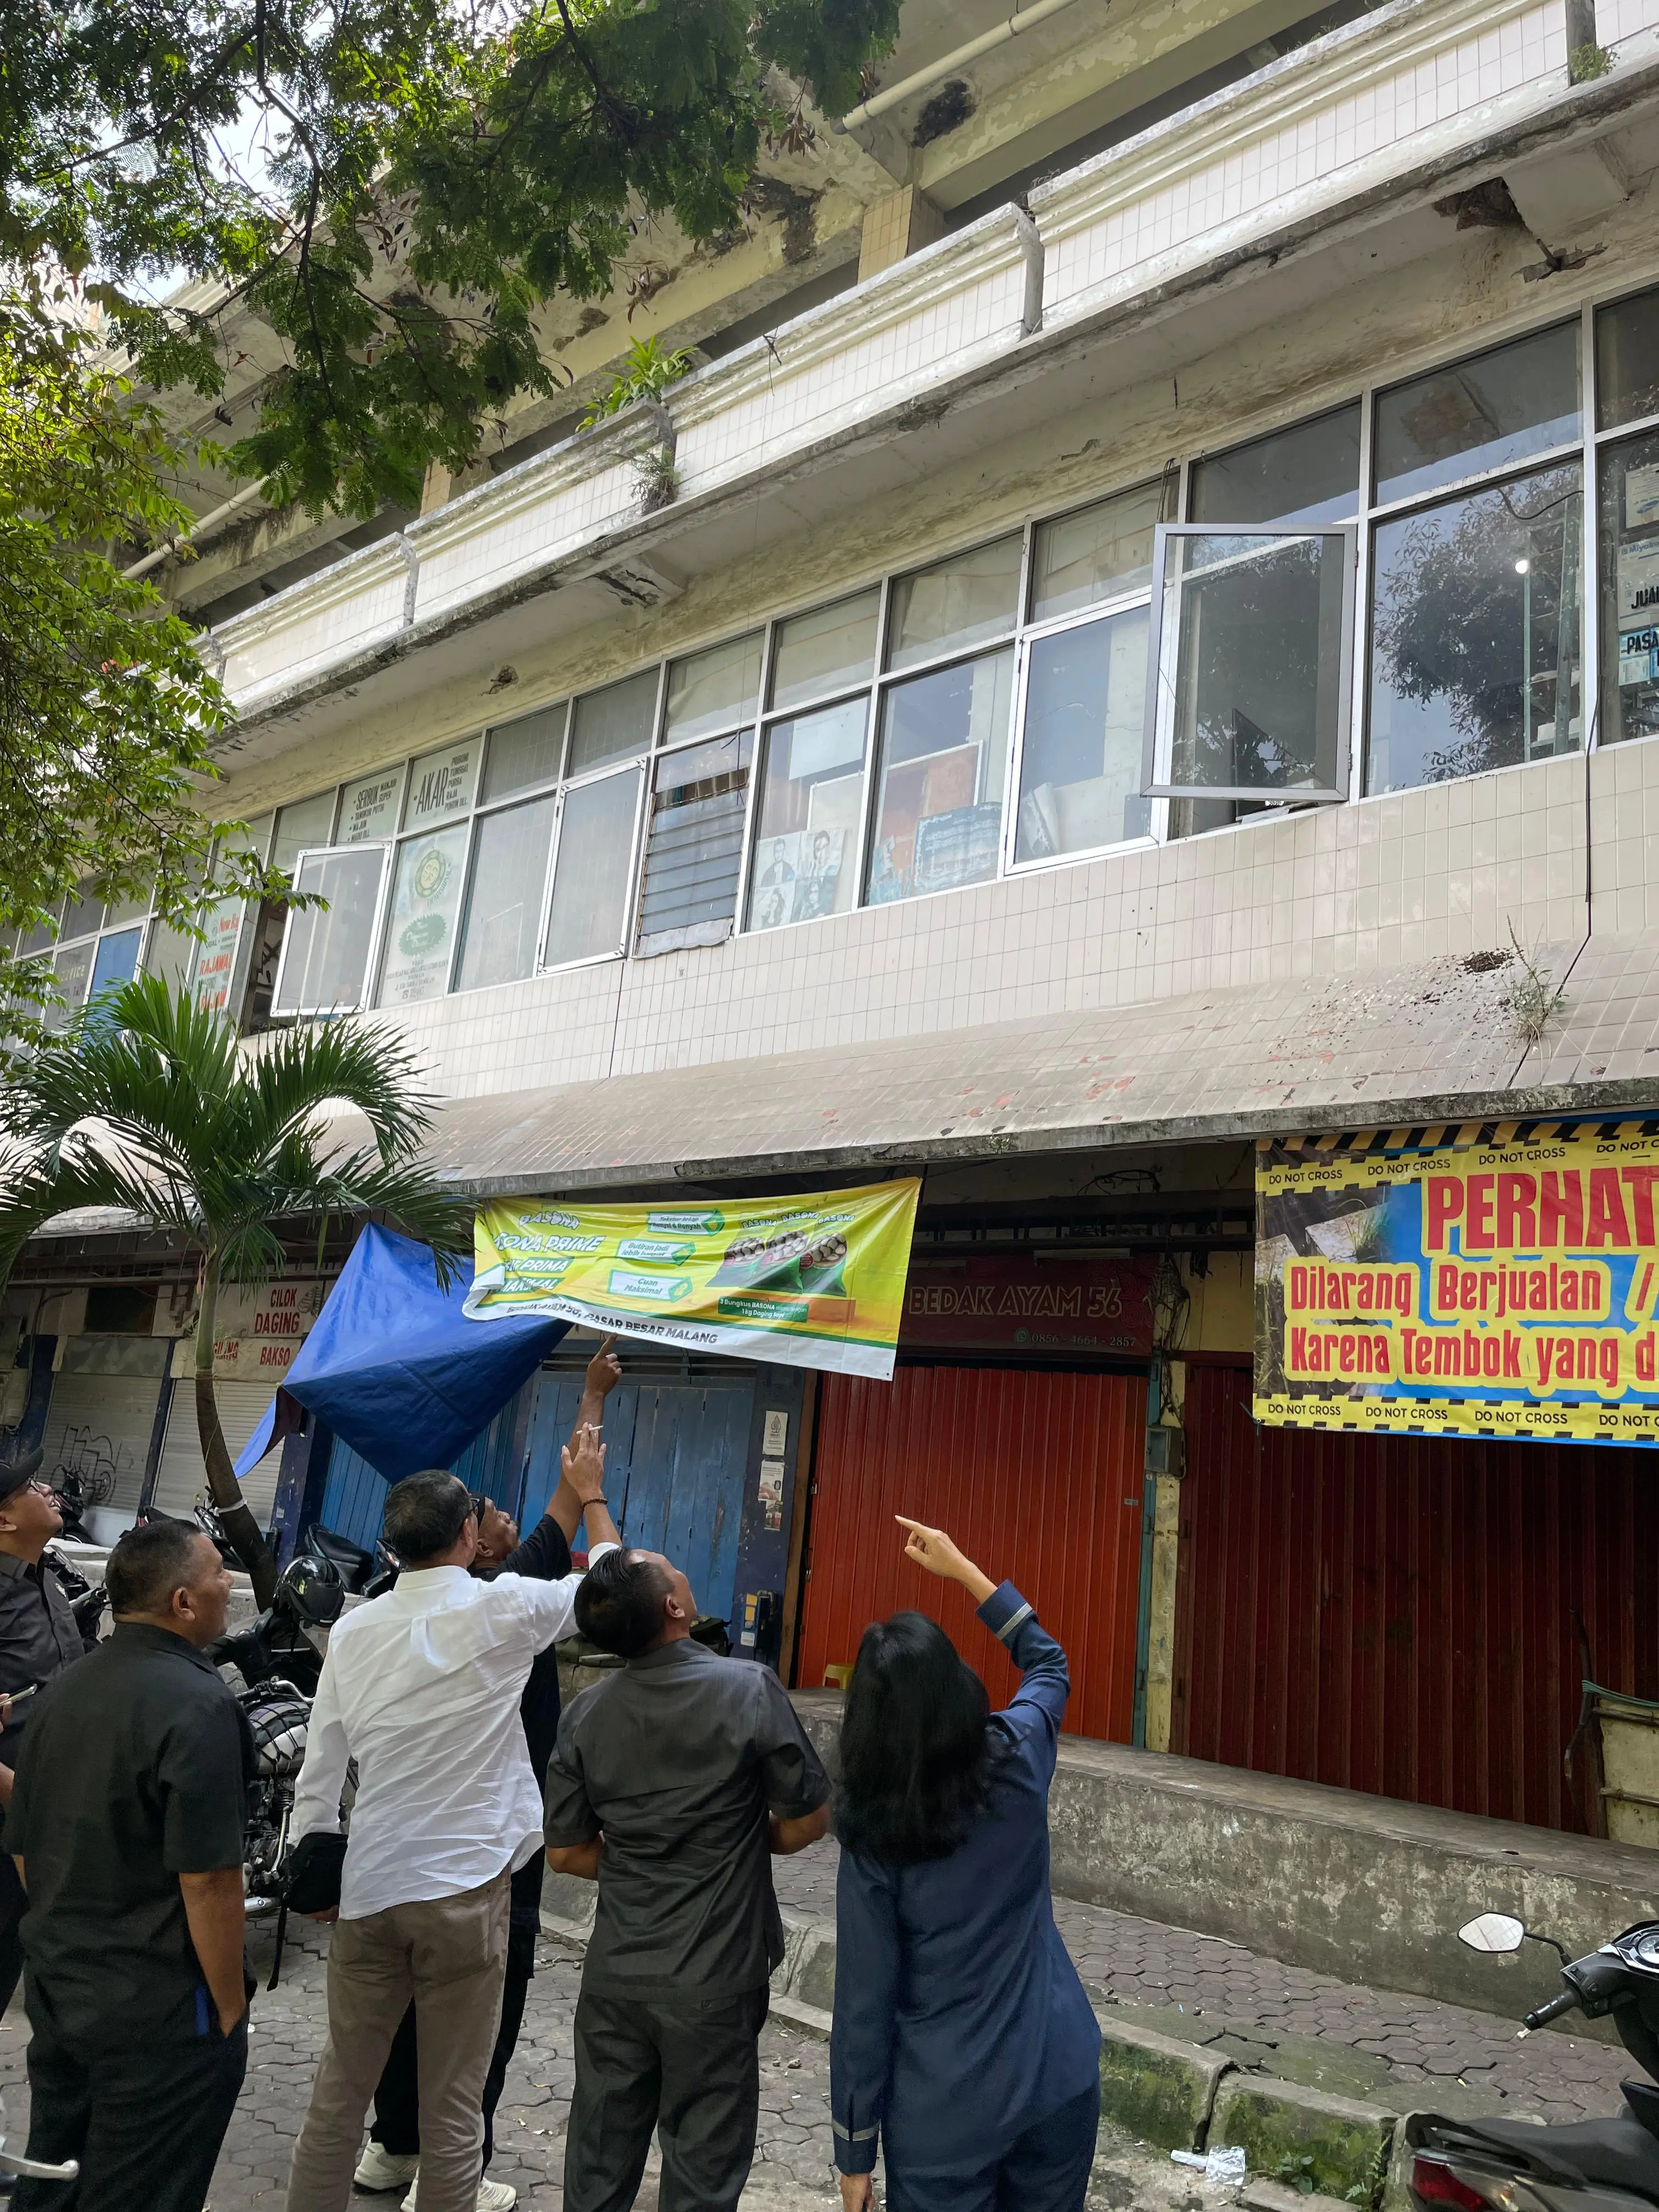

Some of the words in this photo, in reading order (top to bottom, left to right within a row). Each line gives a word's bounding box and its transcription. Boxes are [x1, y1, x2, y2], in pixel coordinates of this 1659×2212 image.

[357, 785, 380, 810] SERBUK
[379, 791, 392, 803] SUPER
[415, 767, 449, 815] AKAR
[1597, 1144, 1616, 1153] DO
[1620, 1141, 1647, 1151] NOT
[1479, 1155, 1496, 1165] DO
[1499, 1152, 1523, 1163] NOT
[1526, 1147, 1566, 1160] CROSS
[1368, 1166, 1383, 1176] DO
[1387, 1163, 1410, 1173] NOT
[1413, 1159, 1451, 1171] CROSS
[1269, 1175, 1282, 1184] DO
[1284, 1173, 1305, 1182] NOT
[1308, 1169, 1342, 1181] CROSS
[518, 1210, 580, 1230] BASONA
[742, 1218, 777, 1229] BASONA
[780, 1211, 820, 1222] BASONA
[818, 1214, 855, 1225] BASONA
[494, 1232, 543, 1251] ASONA
[543, 1235, 607, 1252] PRIME
[628, 1242, 654, 1251] Butiran
[519, 1259, 569, 1272] PRIMA
[637, 1278, 658, 1286] Cuan
[624, 1284, 663, 1295] Maksimal
[1291, 1265, 1412, 1317] Dilarang
[1438, 1262, 1601, 1318] Berjualan
[1635, 1262, 1655, 1311] /
[270, 1288, 298, 1308] CILOK
[724, 1299, 751, 1308] Bungkus
[752, 1302, 775, 1310] BASONA
[909, 1285, 996, 1316] BEDAK
[996, 1285, 1081, 1317] AYAM
[1087, 1286, 1122, 1318] 56
[254, 1312, 300, 1334] DAGING
[625, 1321, 665, 1335] BESAR
[666, 1328, 718, 1344] MALANG
[1031, 1333, 1059, 1344] 0856
[1071, 1335, 1097, 1345] 4664
[1109, 1336, 1137, 1347] 2857
[259, 1346, 290, 1367] BAKSO
[1291, 1327, 1390, 1373] Karena
[1400, 1328, 1521, 1378] Tembok
[1536, 1338, 1618, 1388] yang
[1268, 1404, 1284, 1413] DO
[1286, 1404, 1306, 1414] NOT
[1308, 1406, 1341, 1415] CROSS
[1366, 1407, 1381, 1417] DO
[1385, 1408, 1407, 1418] NOT
[1410, 1408, 1448, 1419] CROSS
[1475, 1410, 1492, 1422] DO
[1496, 1412, 1522, 1423] NOT
[1525, 1413, 1568, 1424] CROSS
[1599, 1414, 1618, 1426] DO
[1623, 1415, 1650, 1426] NOT
